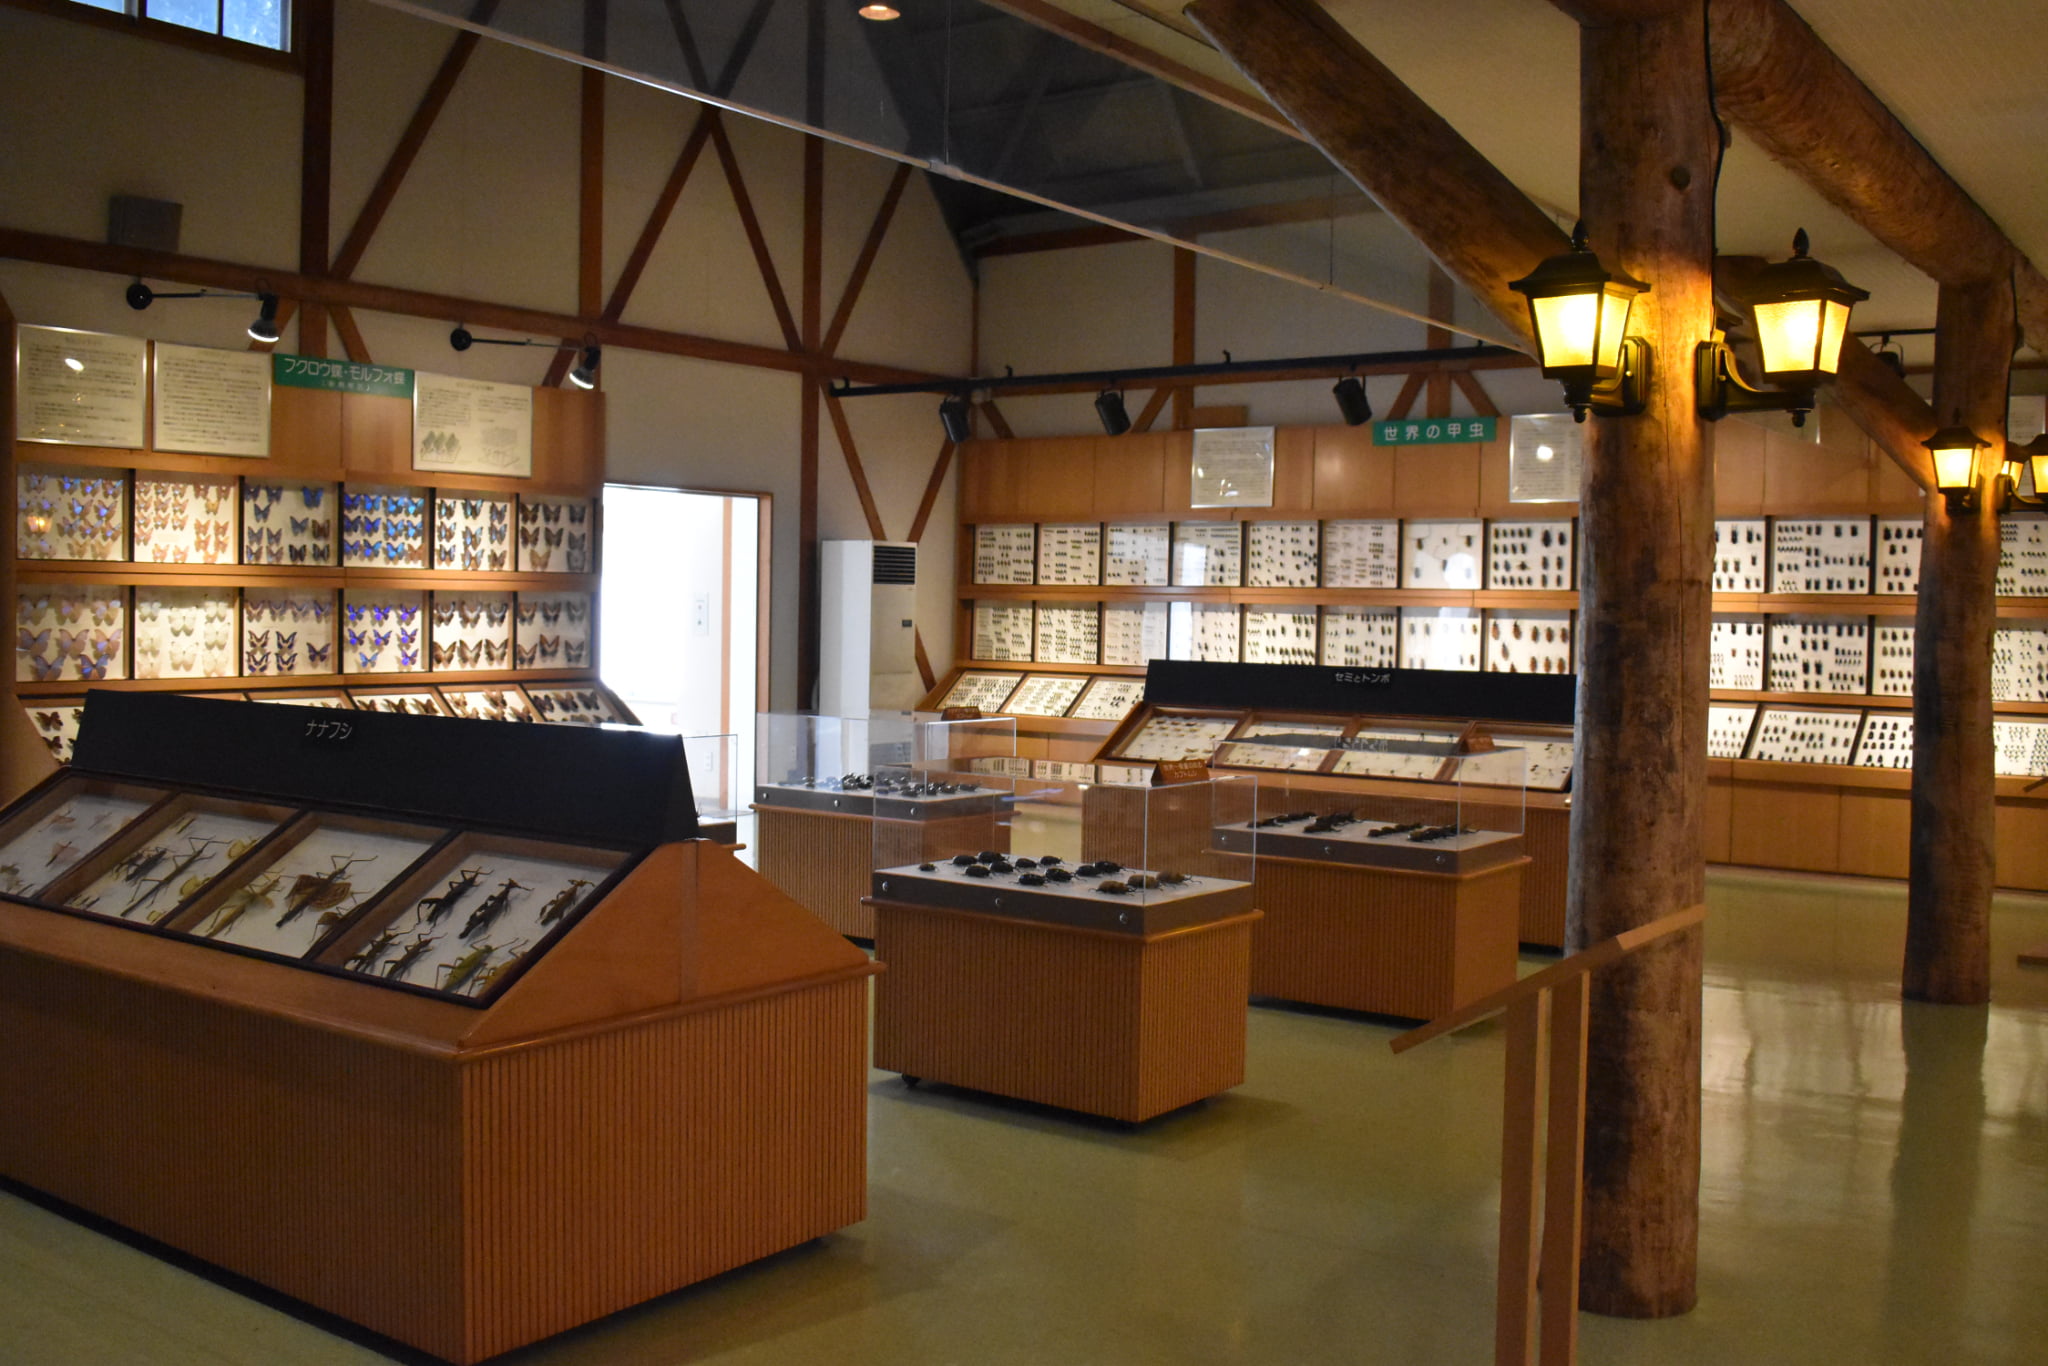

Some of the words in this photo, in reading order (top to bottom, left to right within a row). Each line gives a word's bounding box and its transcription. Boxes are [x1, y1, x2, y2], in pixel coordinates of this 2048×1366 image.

[1384, 422, 1484, 441] 世界の甲虫
[1335, 672, 1391, 683] セミとトンボ
[305, 719, 353, 739] ナナフシ
